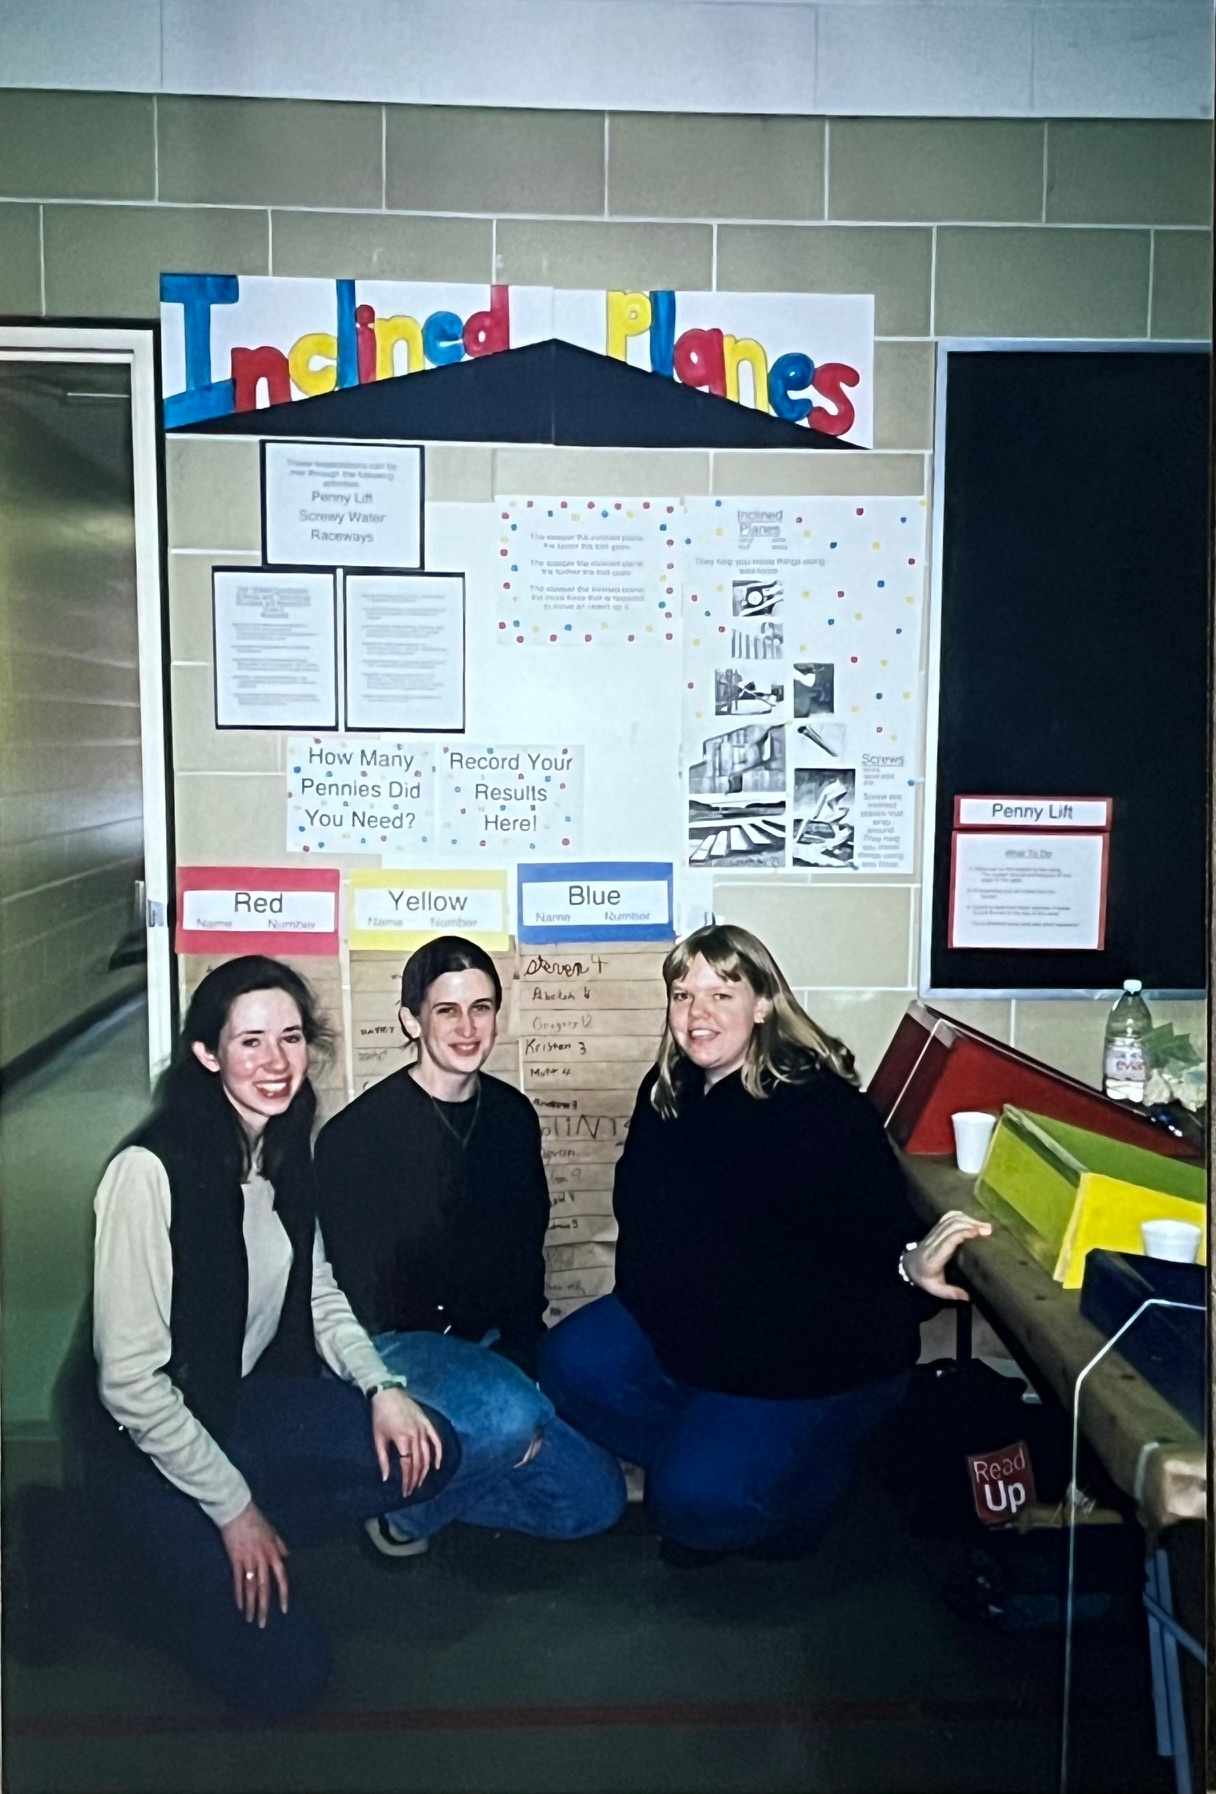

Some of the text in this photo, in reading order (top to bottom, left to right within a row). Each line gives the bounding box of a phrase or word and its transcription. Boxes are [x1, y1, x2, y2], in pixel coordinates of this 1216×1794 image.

[160, 273, 510, 428] Inclined
[311, 491, 373, 506] Penny Lift
[299, 510, 387, 525] Screwy Water
[737, 510, 783, 521] Inclined
[311, 529, 374, 544] Raceways
[308, 747, 414, 772] How Many
[450, 752, 573, 771] Record Your
[861, 753, 904, 766] Screws
[301, 778, 421, 799] Pennies Did
[475, 784, 547, 802] Results
[305, 809, 416, 829] You Need?
[992, 803, 1073, 822] Penny Lift
[484, 814, 537, 832] Here!
[234, 892, 283, 914] Red
[388, 890, 468, 912] Yellow
[568, 885, 621, 906] Blue
[196, 918, 316, 929] Name Number
[367, 917, 478, 928] Name Number
[535, 910, 651, 923] Name Number
[532, 1016, 578, 1032] Gregory
[578, 1041, 587, 1055] 3
[973, 1446, 1026, 1484] Read
[984, 1480, 1026, 1514] Up
